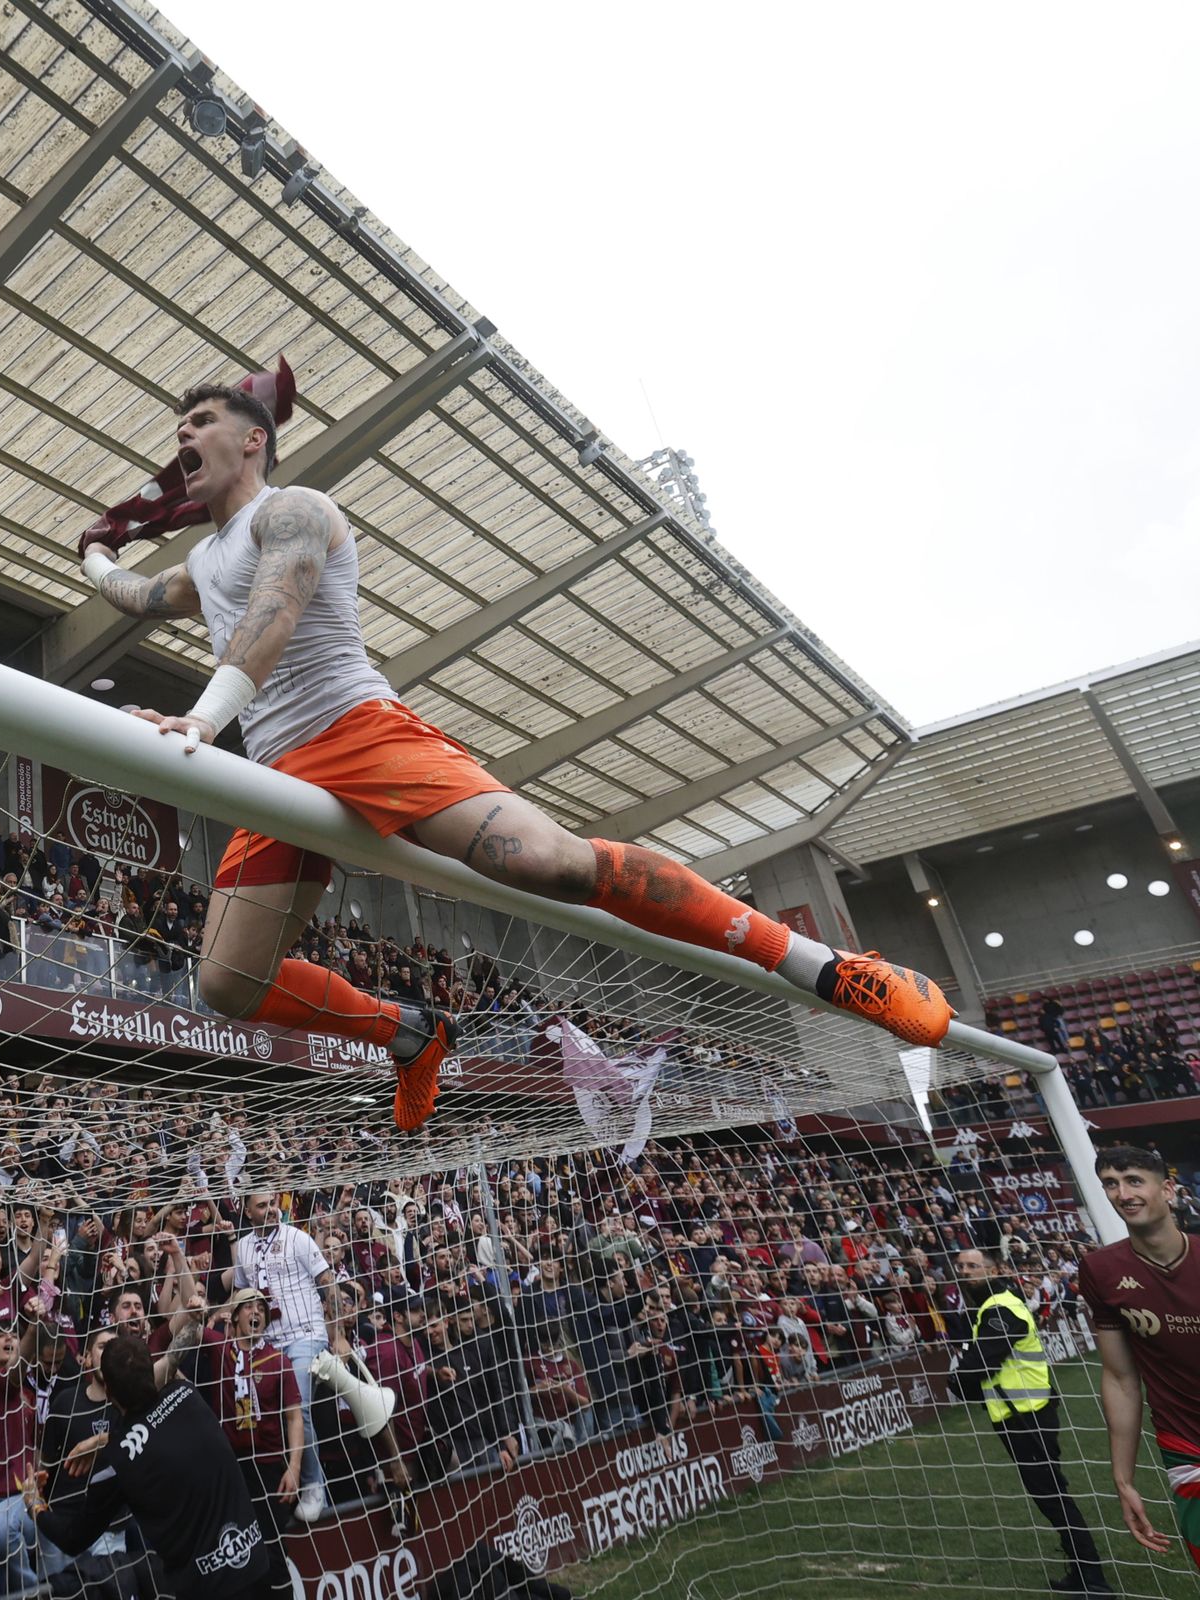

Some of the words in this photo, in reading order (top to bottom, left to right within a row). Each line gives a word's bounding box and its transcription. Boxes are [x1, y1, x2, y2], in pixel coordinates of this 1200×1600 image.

[81, 799, 149, 839] Estrella
[84, 823, 147, 861] Galicia
[69, 1000, 165, 1046] Estrella
[169, 1015, 251, 1057] Galicia
[991, 1170, 1061, 1195] FOSSA
[841, 1374, 883, 1400] CONSERVAS
[822, 1389, 913, 1458] PESCAMAR
[615, 1432, 689, 1480] CONSERAS
[730, 1441, 779, 1476] PESCAMAR
[582, 1455, 728, 1553] PESCAMAR
